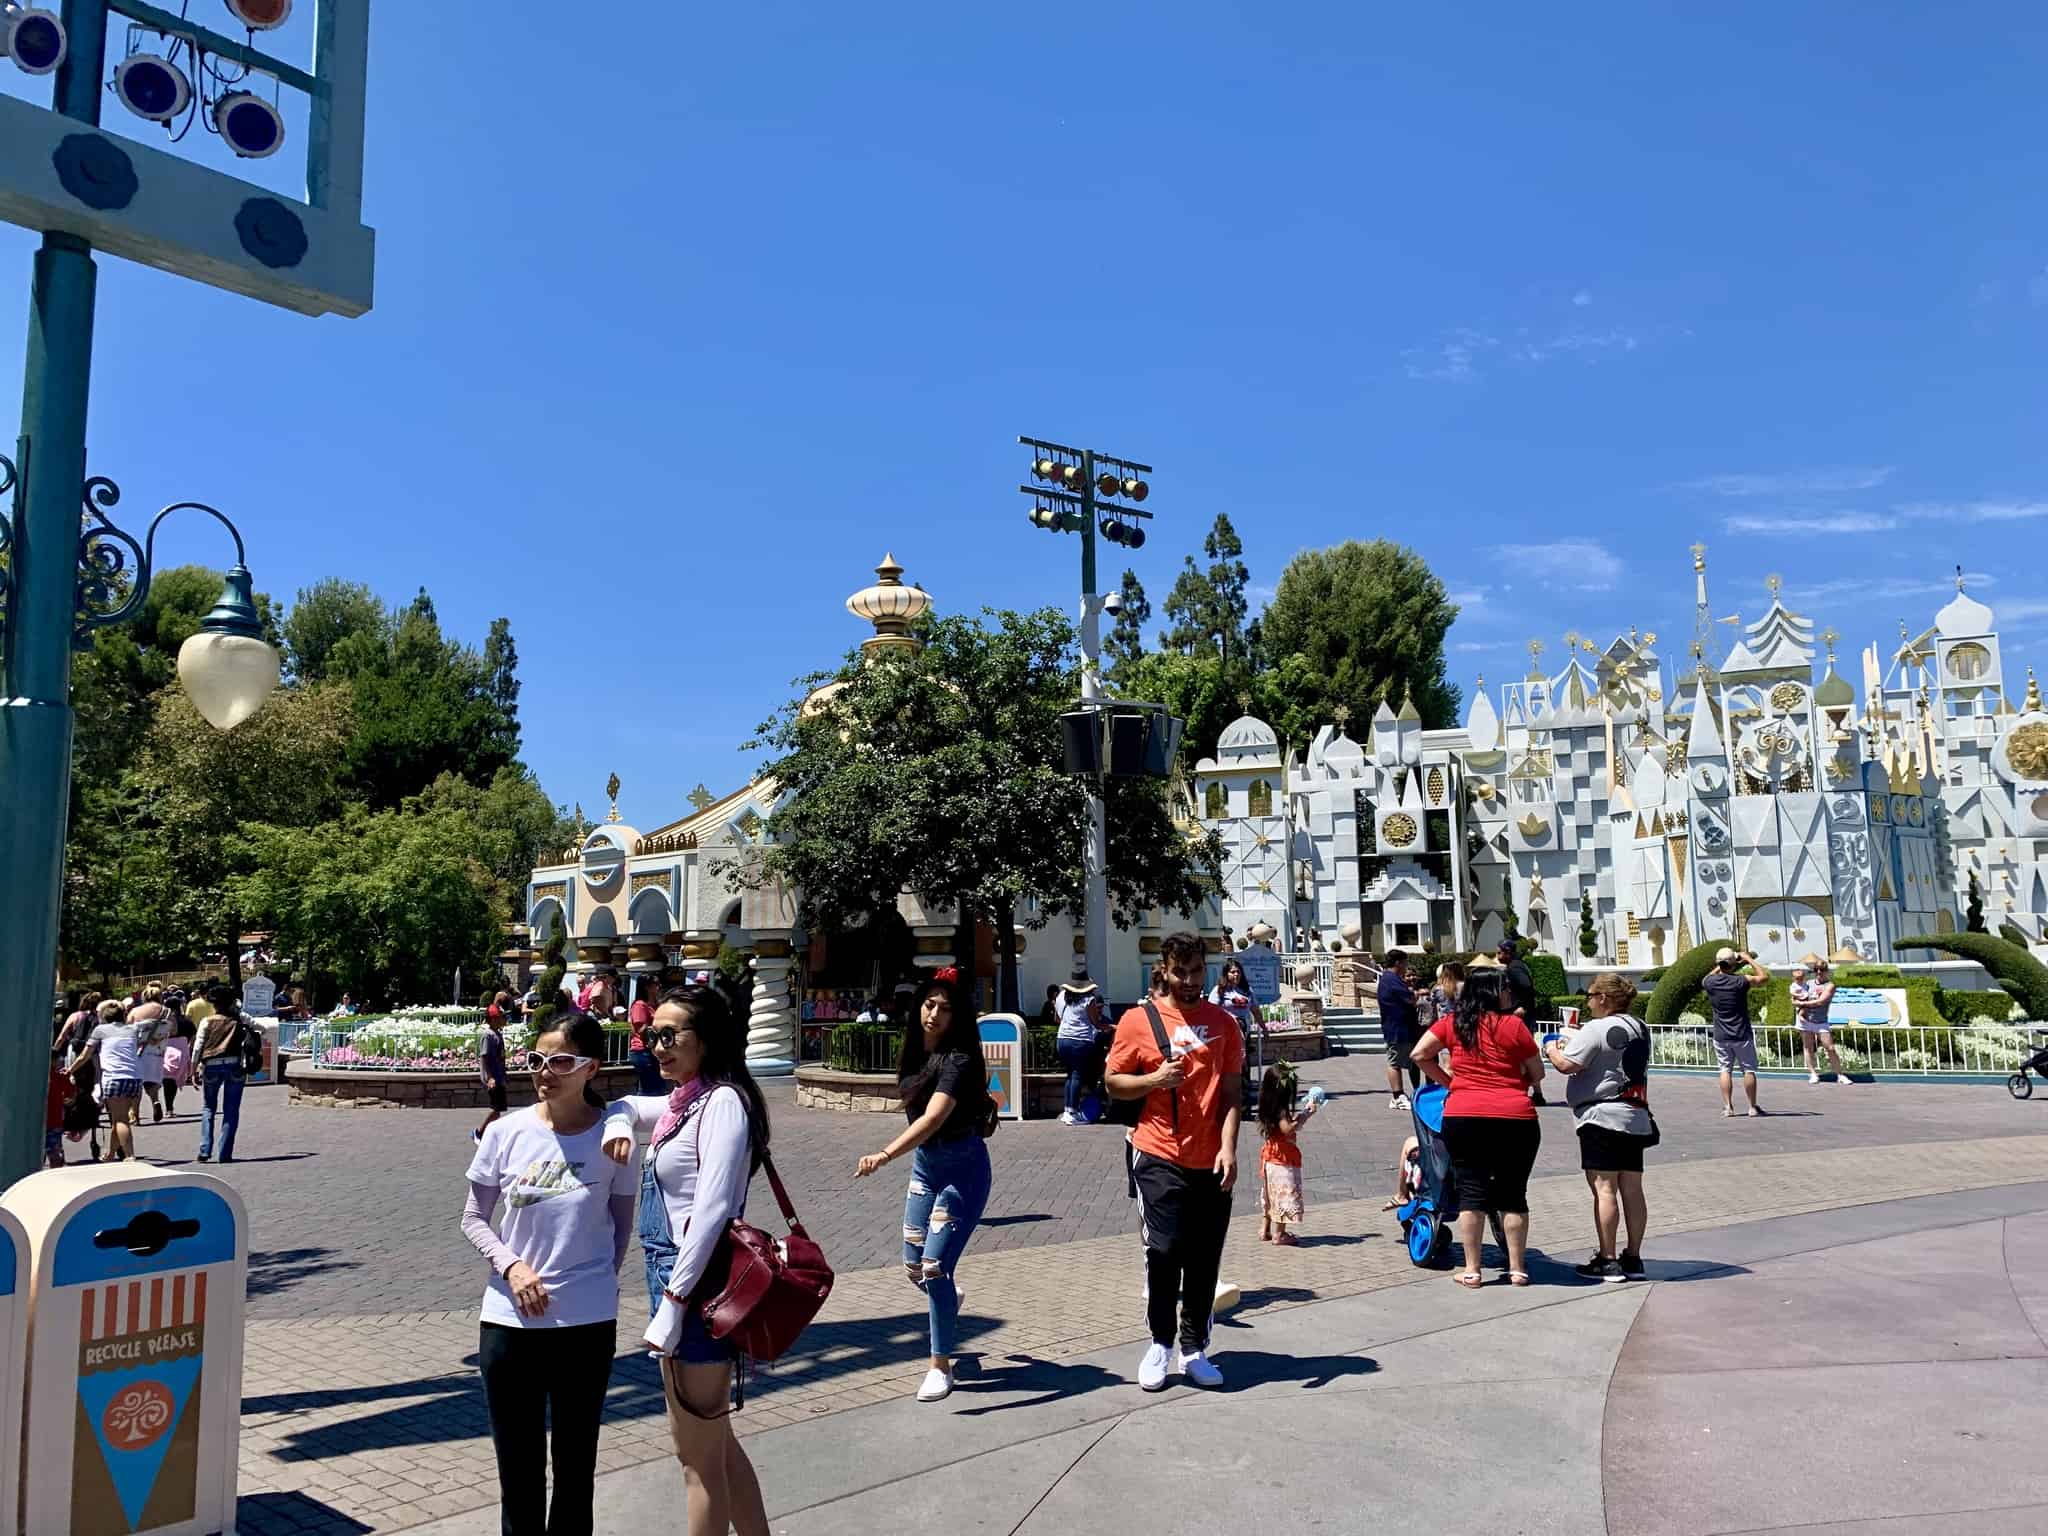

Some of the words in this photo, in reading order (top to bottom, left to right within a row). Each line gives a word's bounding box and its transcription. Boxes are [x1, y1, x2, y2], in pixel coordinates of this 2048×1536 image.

[1174, 1025, 1209, 1042] NIKE
[86, 1340, 142, 1366] RECYCLE
[147, 1331, 196, 1356] PLEASE
